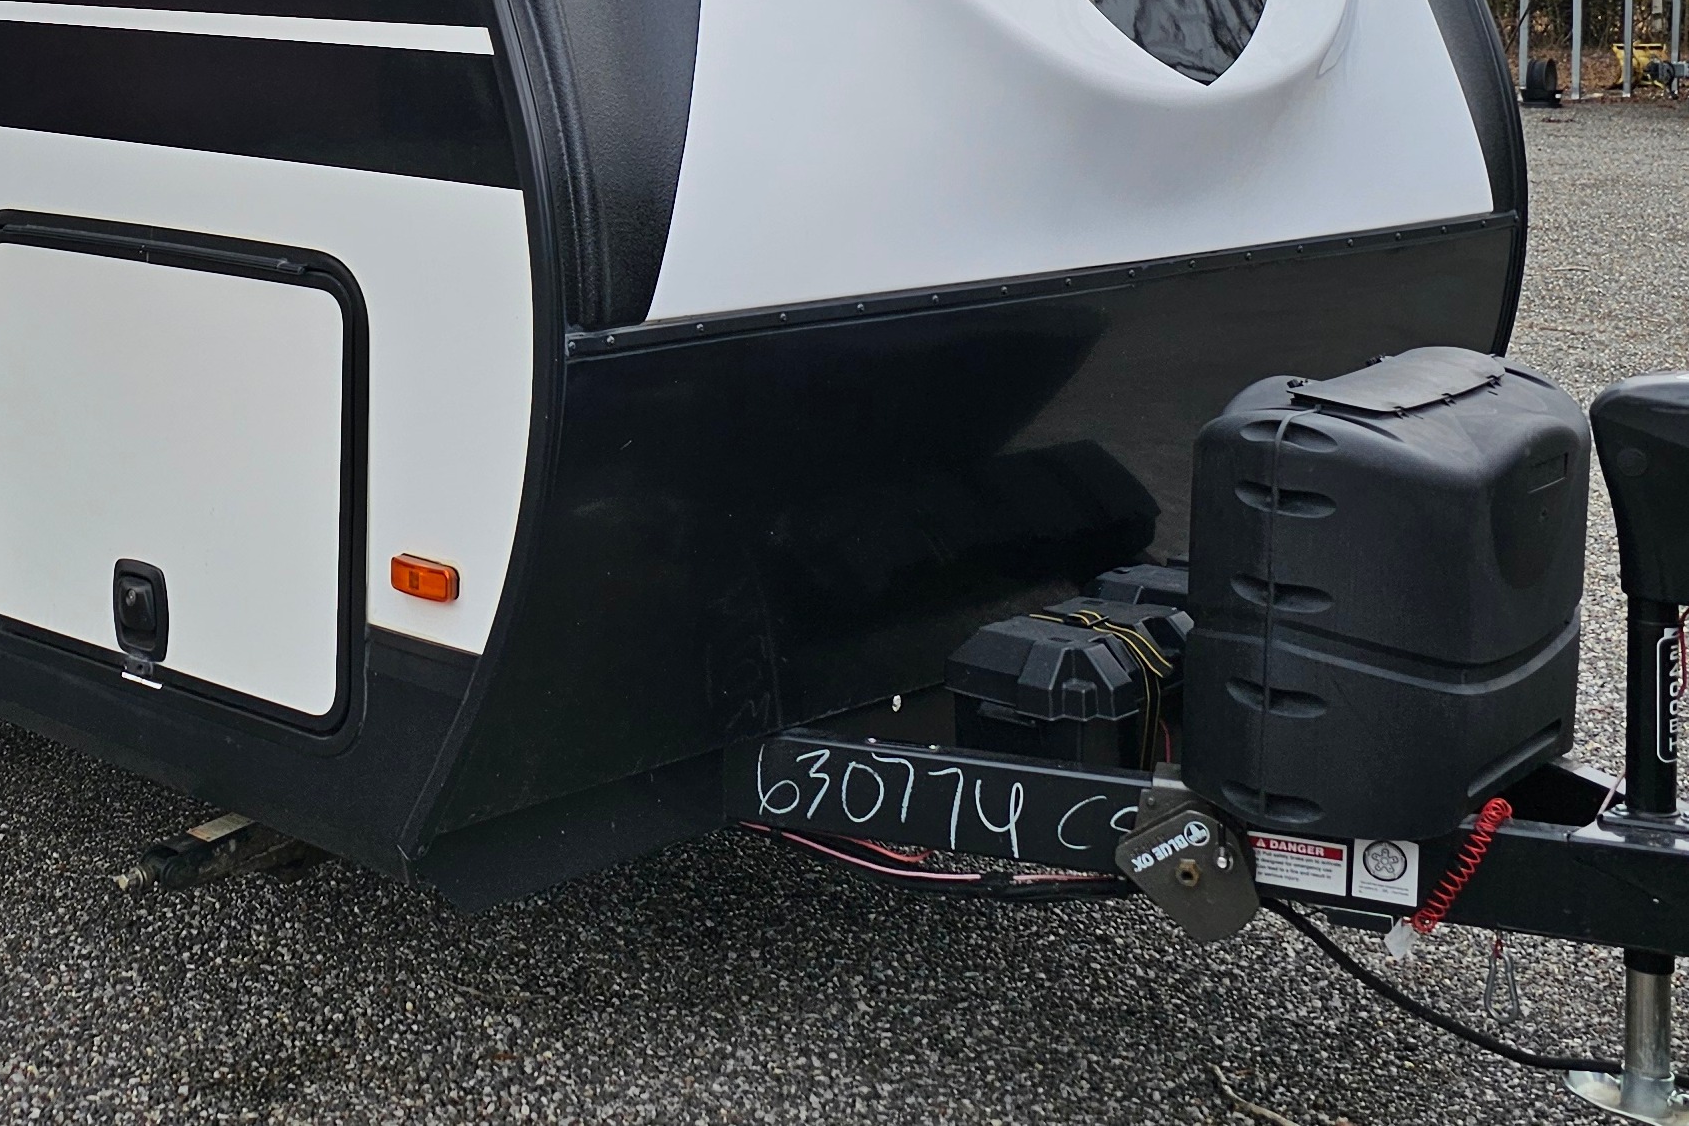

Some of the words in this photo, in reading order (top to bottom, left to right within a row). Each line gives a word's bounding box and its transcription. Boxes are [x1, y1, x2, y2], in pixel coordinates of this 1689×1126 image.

[756, 743, 1024, 859] 630774
[1151, 834, 1189, 862] BLUE
[1269, 838, 1325, 857] DANGER
[1131, 852, 1155, 873] OX
